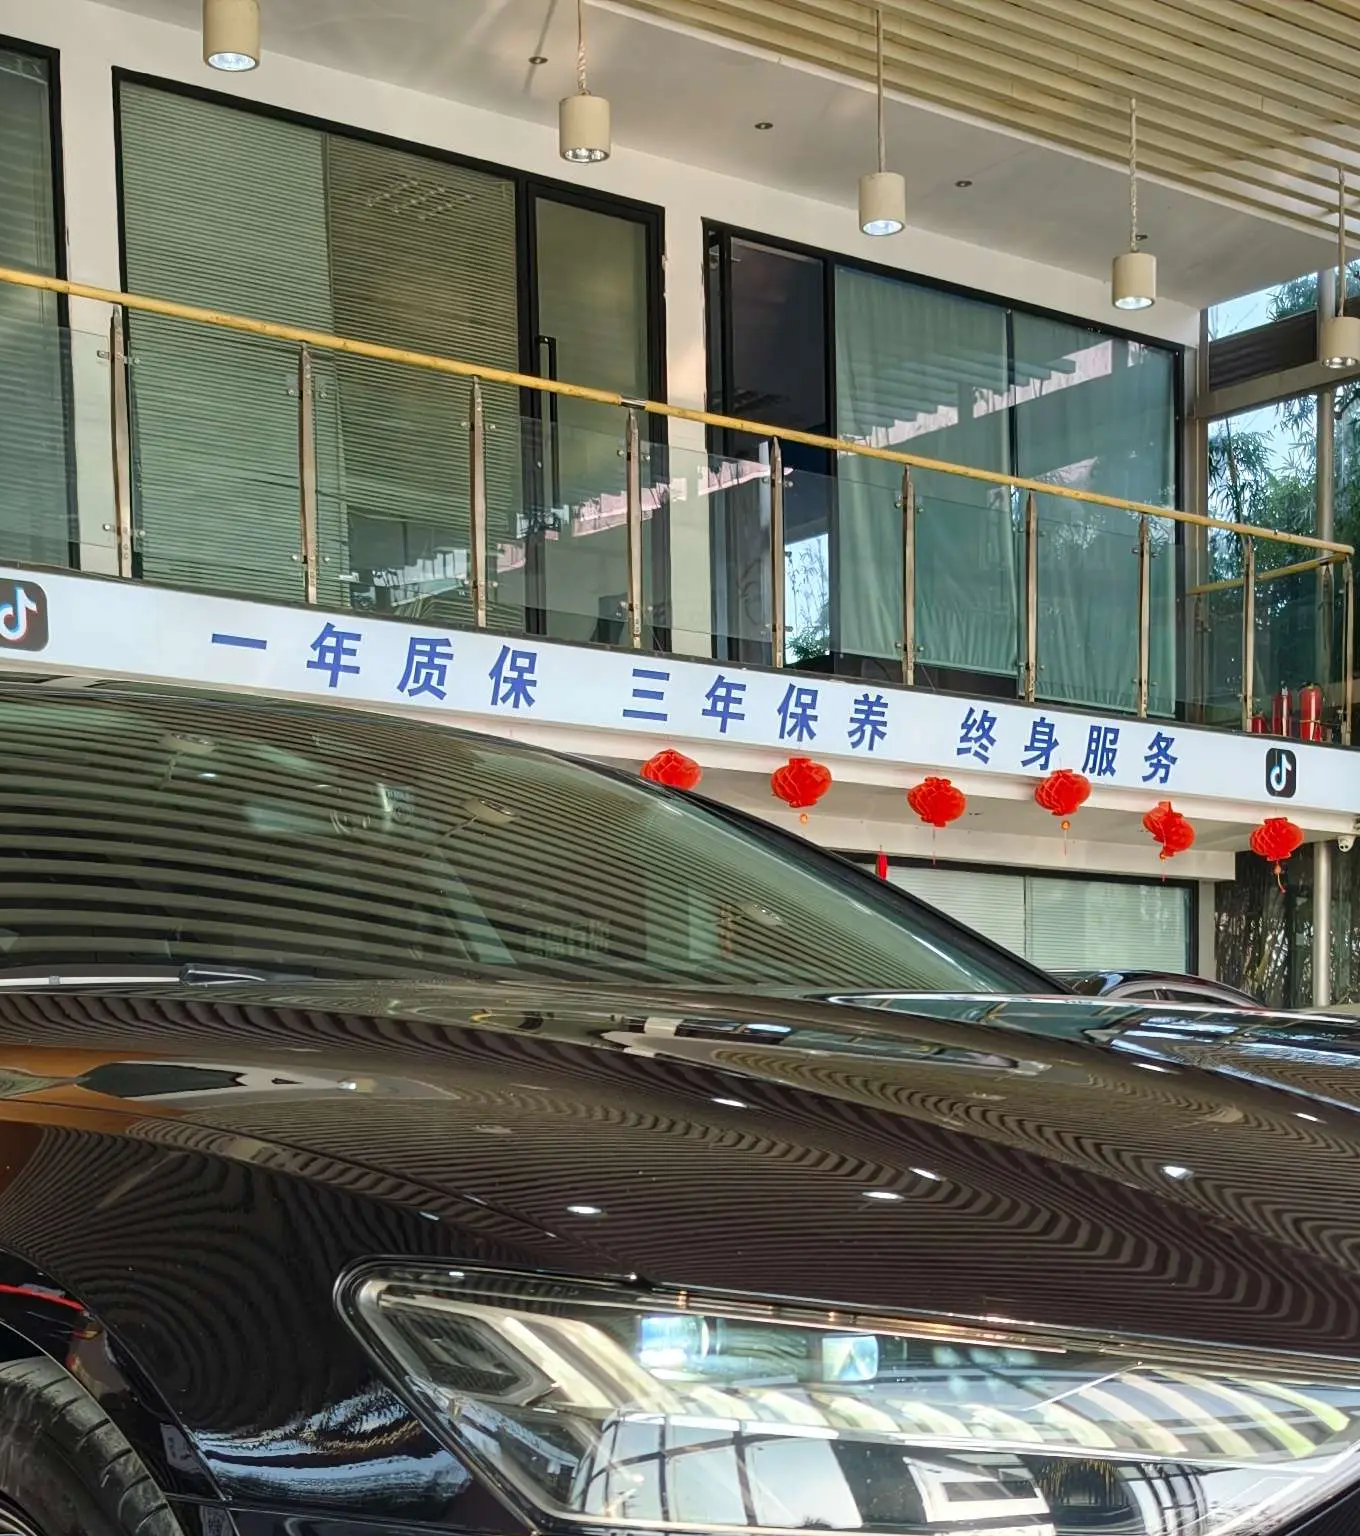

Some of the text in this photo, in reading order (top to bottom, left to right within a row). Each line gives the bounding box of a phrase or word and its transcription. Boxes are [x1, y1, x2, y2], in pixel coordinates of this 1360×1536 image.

[210, 622, 1180, 785] 一年质保 三年保养 终身服务
